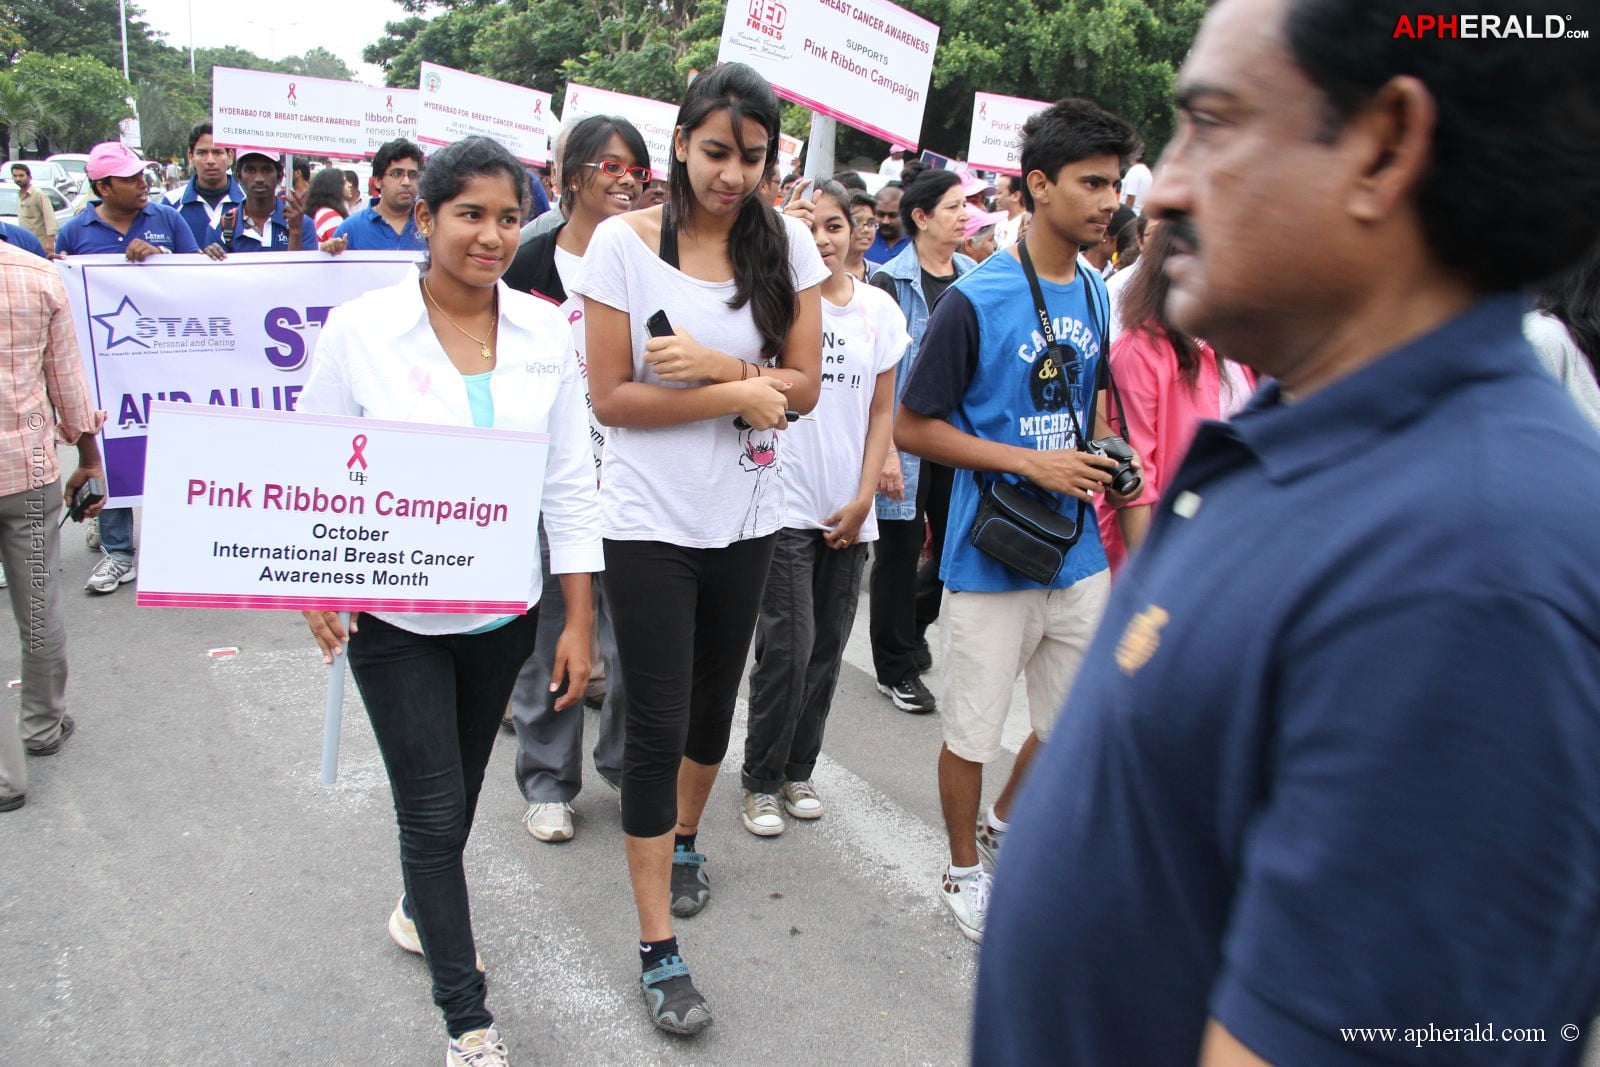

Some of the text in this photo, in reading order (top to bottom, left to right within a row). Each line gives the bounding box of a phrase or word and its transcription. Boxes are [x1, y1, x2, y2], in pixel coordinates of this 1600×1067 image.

[746, 18, 761, 31] FM
[761, 24, 783, 41] 93.5
[852, 7, 884, 33] CANCER
[884, 23, 930, 54] AWARENESS
[845, 39, 889, 65] SUPPORTS
[803, 38, 828, 61] Pink
[830, 50, 868, 78] Ribbon
[870, 69, 920, 102] Campaign
[219, 107, 361, 127] HYDERABAD FOR BREAST CANCER AWARENESS
[365, 112, 394, 123] ibbon
[424, 101, 457, 115] HYDERABAD
[458, 108, 469, 117] FOR
[471, 112, 492, 122] BREAST
[493, 118, 514, 129] CANCER
[991, 120, 1011, 132] Pink
[223, 127, 357, 145] CELEBRATING SIX POSITIVELY EVENTFUL YEARS
[982, 135, 1001, 147] Join
[135, 316, 234, 338] STAR
[1038, 309, 1054, 343] SONY
[153, 338, 236, 349] Personal and Caring
[822, 332, 846, 349] No
[1038, 358, 1058, 380] &
[186, 479, 509, 528] Pink Ribbon Campaign
[311, 523, 390, 542] October
[212, 541, 475, 567] International Breast Cancer
[258, 565, 430, 587] Awareness Month
